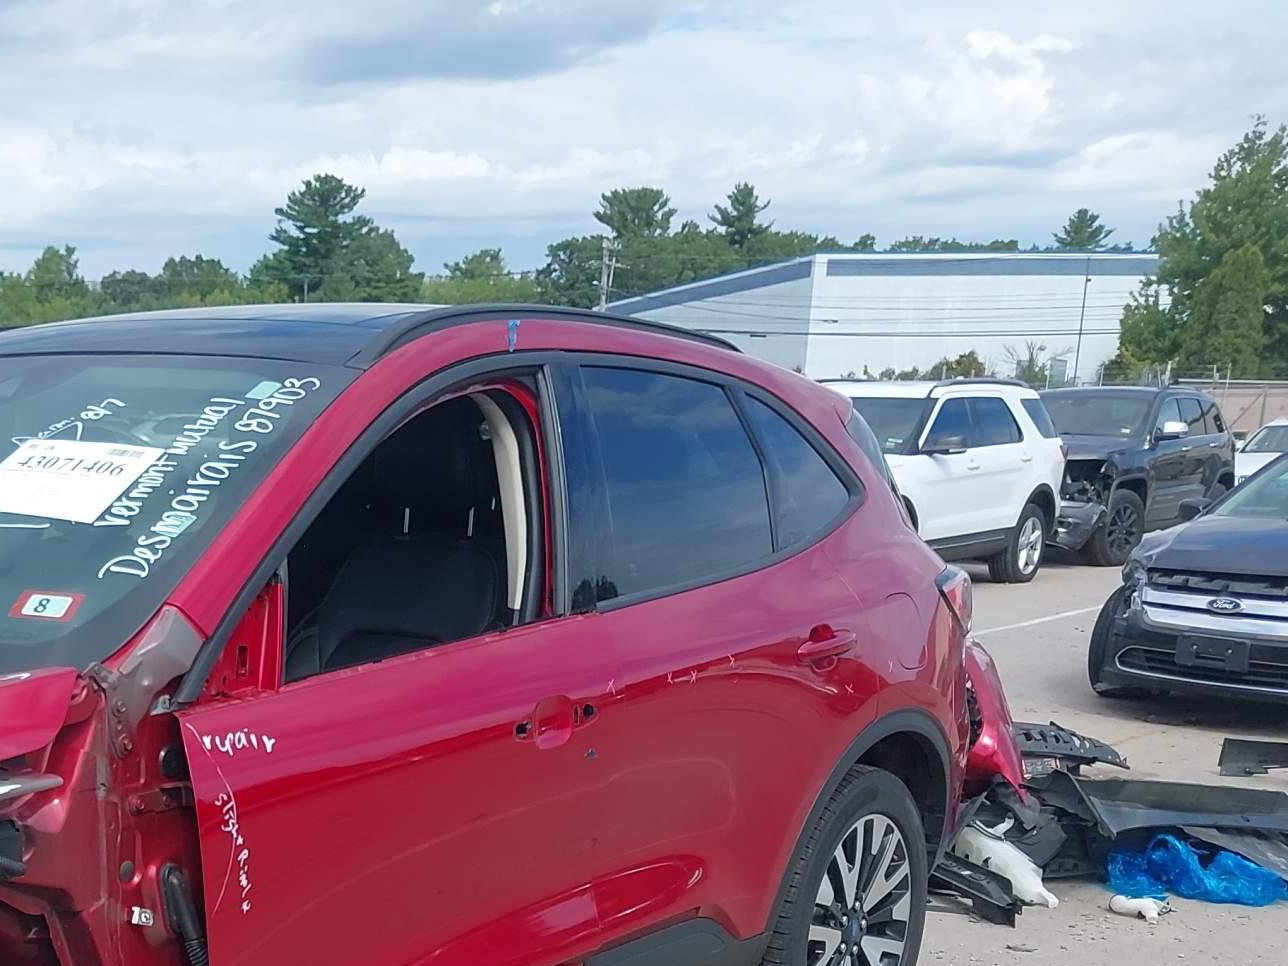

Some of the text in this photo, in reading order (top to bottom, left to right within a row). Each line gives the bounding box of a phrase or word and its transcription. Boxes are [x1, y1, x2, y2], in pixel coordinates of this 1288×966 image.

[234, 376, 321, 434] 87903
[17, 455, 128, 476] 43071406
[33, 598, 51, 613] 8
